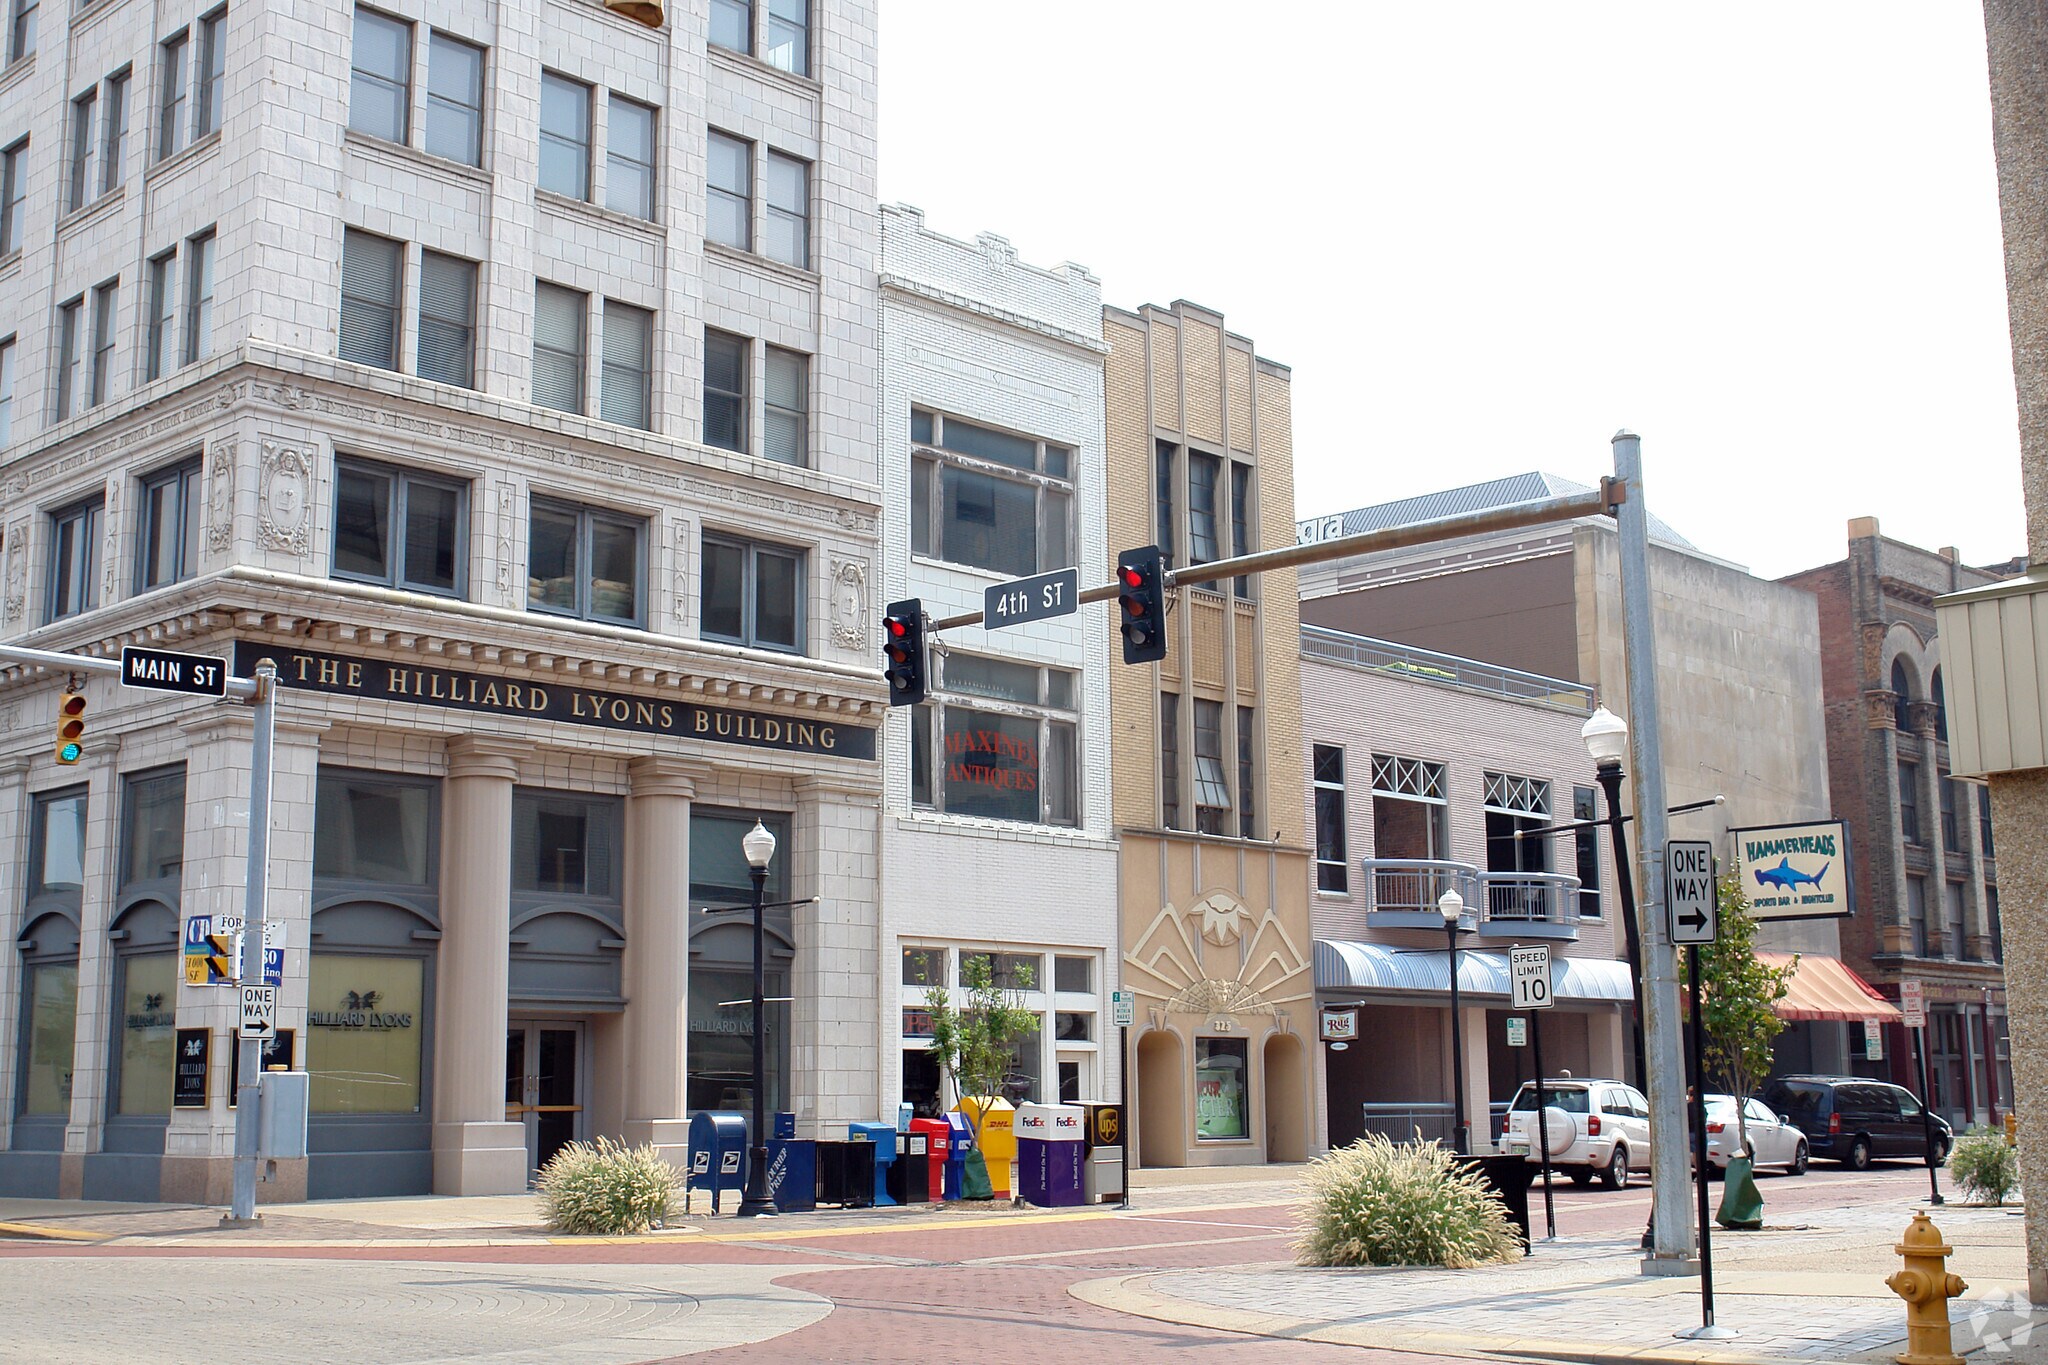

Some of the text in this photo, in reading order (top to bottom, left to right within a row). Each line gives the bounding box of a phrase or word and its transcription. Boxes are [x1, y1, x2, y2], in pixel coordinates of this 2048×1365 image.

[997, 582, 1063, 616] 4th ST
[132, 657, 217, 686] MAIN ST
[293, 656, 836, 748] THE HILLIARD LYONS BUILDING
[946, 763, 1037, 791] ANTIQUES
[1745, 834, 1836, 863] HAMMERHEADS
[1674, 850, 1706, 872] ONE
[1674, 878, 1708, 901] WAY
[1754, 897, 1776, 908] SPORTS
[1778, 896, 1790, 906] BAR
[1801, 894, 1834, 905] NIGHTCLUB
[221, 916, 241, 928] FOR
[1513, 953, 1546, 963] SPEED
[1518, 966, 1543, 976] LIMIT
[245, 989, 272, 1002] ONE
[1521, 979, 1546, 1001] 10
[244, 1004, 272, 1017] WAY
[307, 1011, 412, 1028] HILLIARD LYONS
[689, 1020, 736, 1033] HILLIARD
[1214, 1021, 1231, 1032] 325
[990, 1120, 1009, 1128] DHL
[1022, 1117, 1045, 1127] FedEx
[1056, 1117, 1078, 1127] FedEx
[1100, 1118, 1117, 1138] ups
[767, 1147, 787, 1182] OURIER
